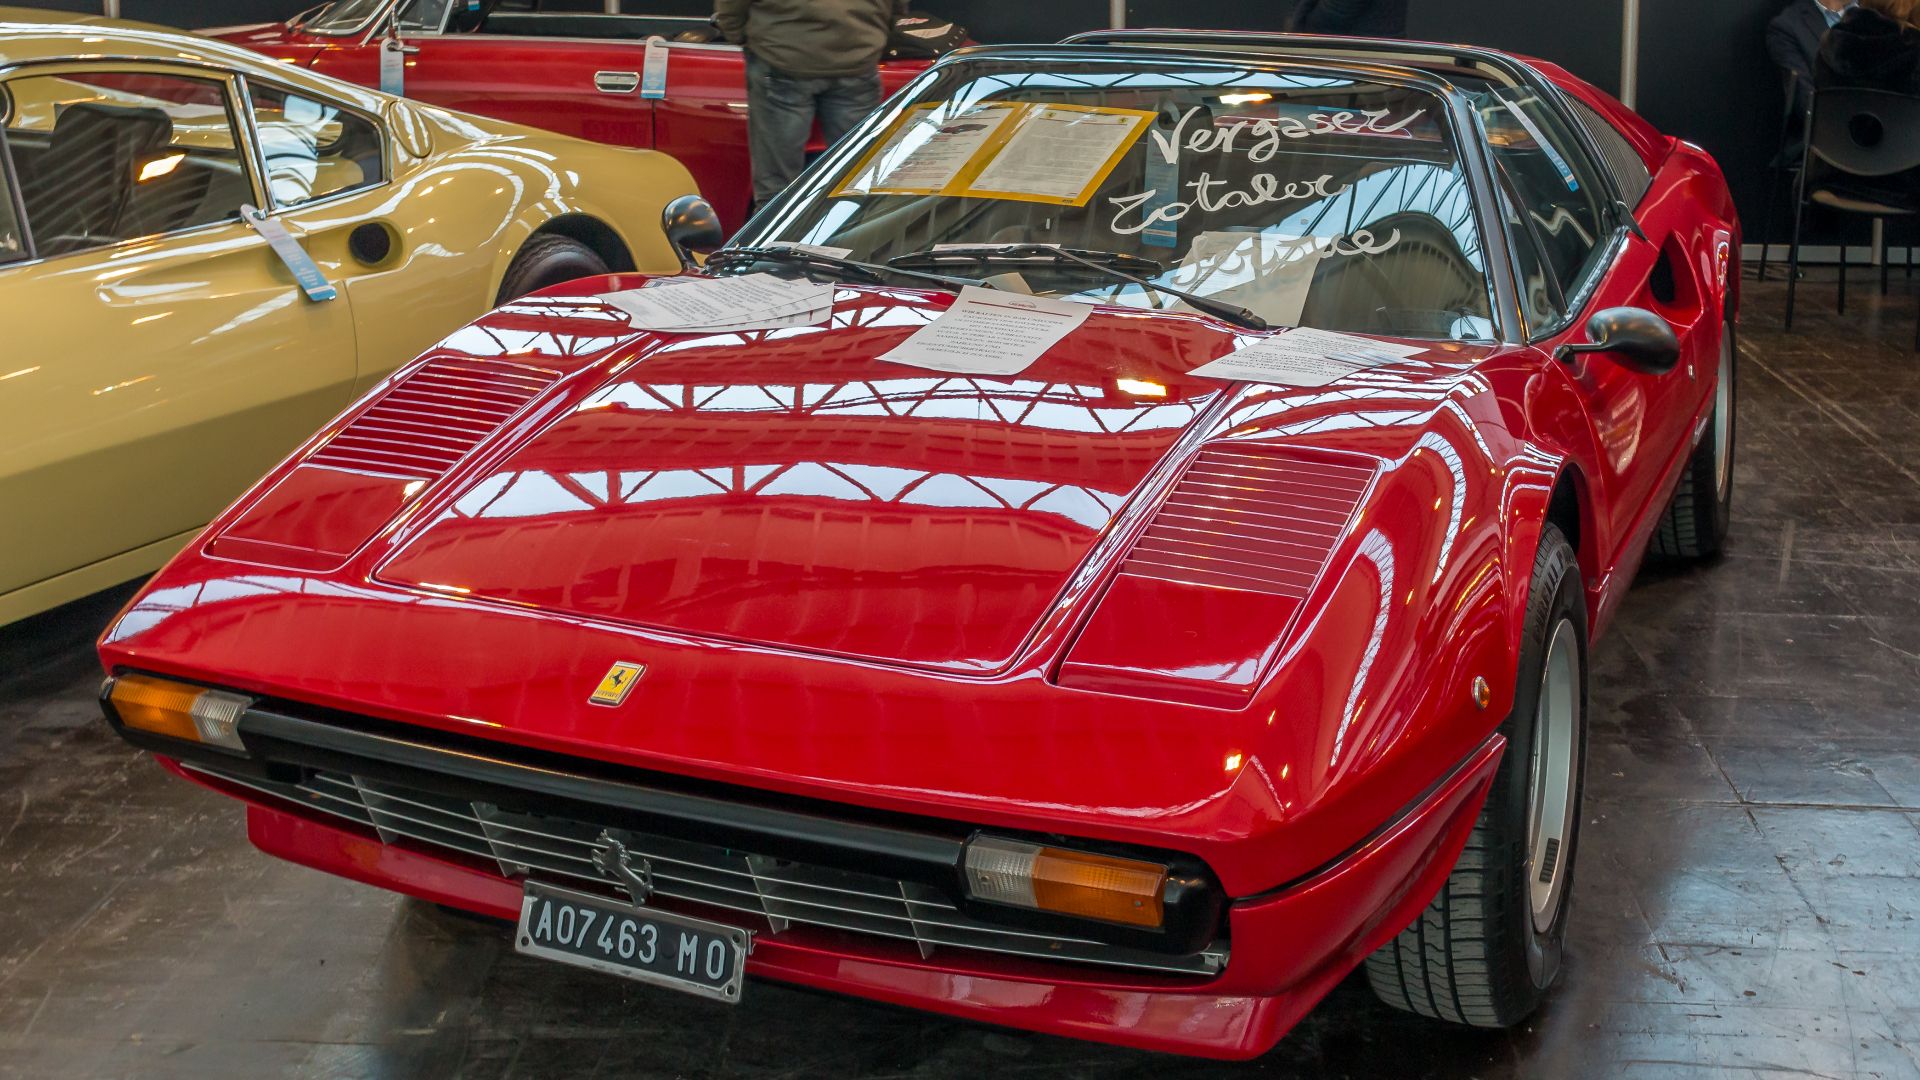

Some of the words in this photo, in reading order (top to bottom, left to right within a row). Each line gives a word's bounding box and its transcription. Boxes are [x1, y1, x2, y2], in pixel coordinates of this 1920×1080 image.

[1152, 106, 1427, 165] Vergaser
[535, 900, 658, 964] A07463
[677, 932, 726, 980] MO
